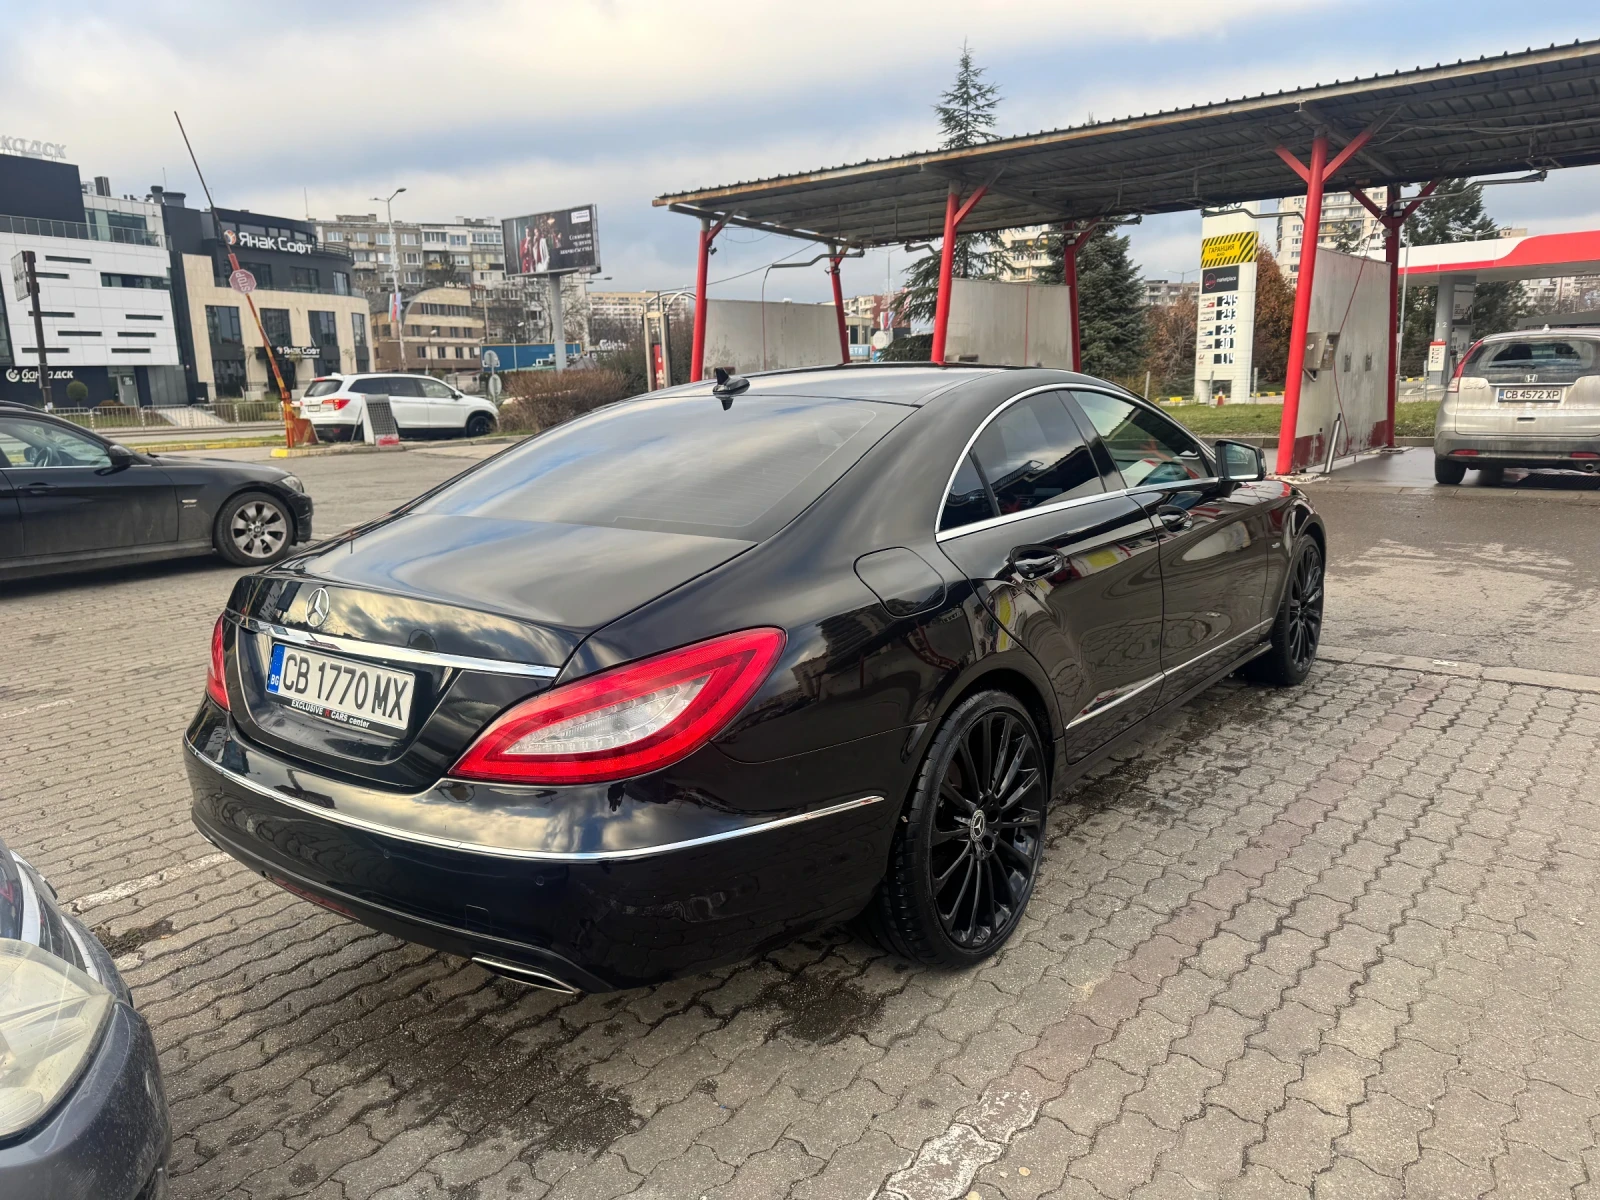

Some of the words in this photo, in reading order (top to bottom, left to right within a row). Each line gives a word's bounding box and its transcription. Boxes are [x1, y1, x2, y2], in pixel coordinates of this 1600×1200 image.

[238, 231, 277, 250] Янак
[277, 236, 313, 254] Софт
[1208, 244, 1235, 254] ГАРАНЦИЯ
[235, 272, 251, 292] STOP
[1505, 390, 1518, 399] CB
[1519, 390, 1544, 399] 4572
[1546, 390, 1560, 399] XP
[270, 674, 280, 686] BG
[283, 653, 311, 695] CB
[317, 661, 370, 710] 1770
[371, 672, 409, 721] MX
[291, 699, 324, 716] EXCLUSIVE
[331, 710, 348, 723] CARS
[348, 717, 371, 729] center
